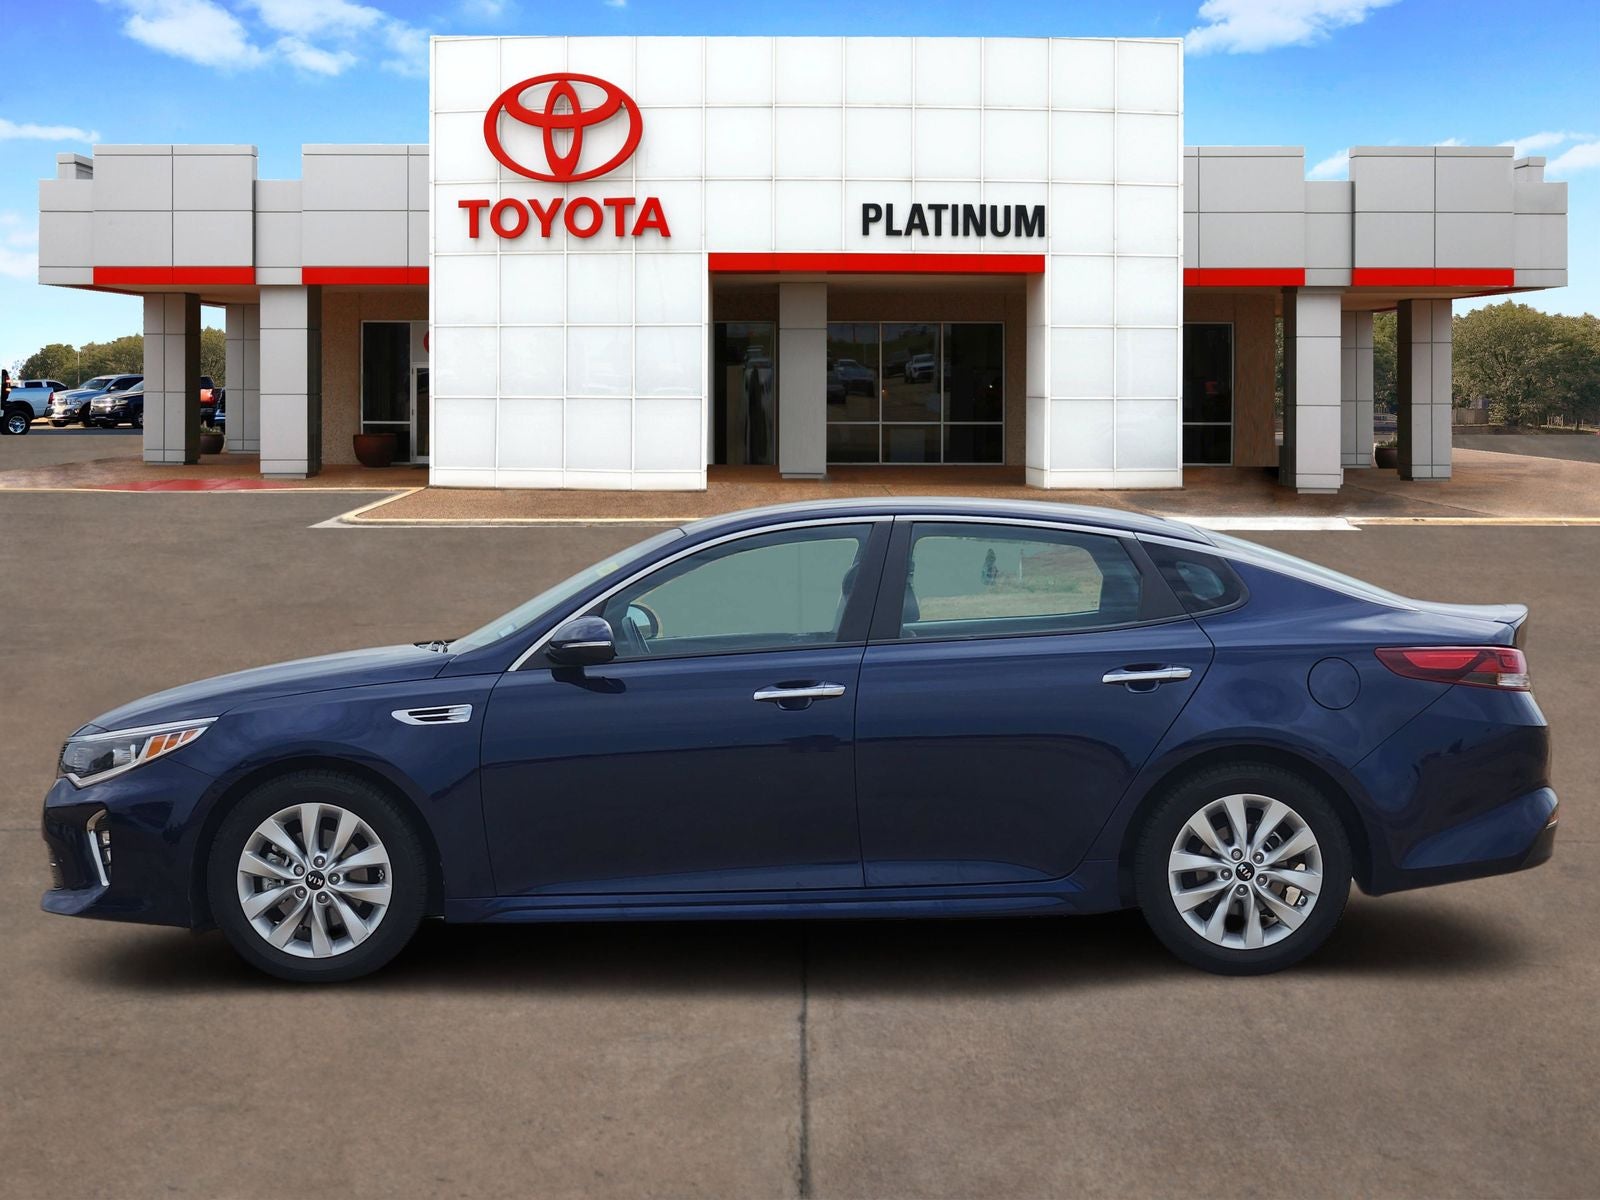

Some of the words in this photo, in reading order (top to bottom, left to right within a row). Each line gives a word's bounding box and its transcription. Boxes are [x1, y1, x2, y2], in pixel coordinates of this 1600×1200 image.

[458, 196, 671, 239] TOYOTA
[862, 203, 1045, 238] PLATINUM
[307, 874, 324, 886] KIA
[1237, 864, 1251, 880] KIA
